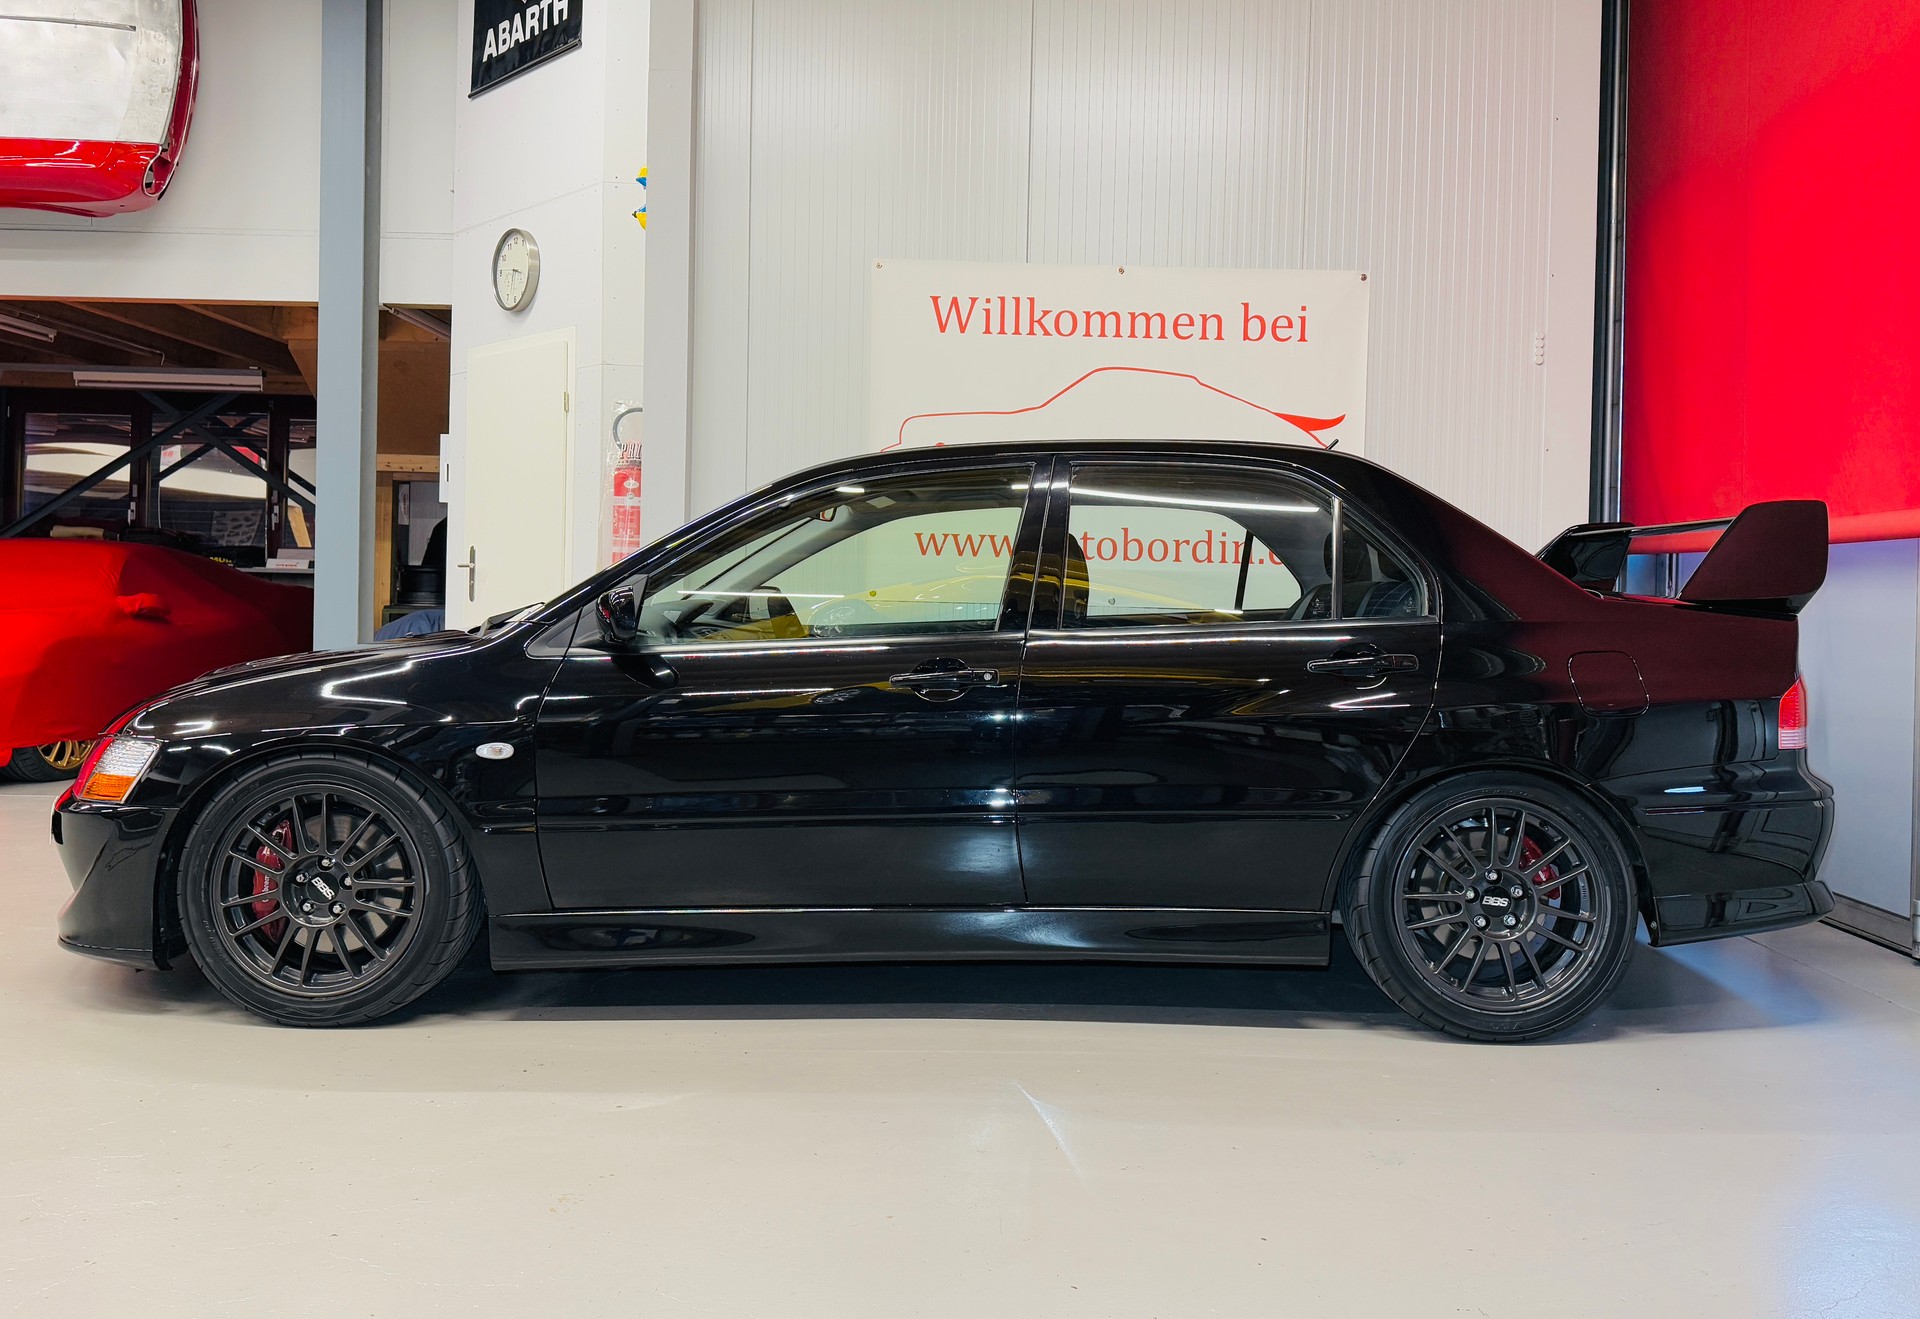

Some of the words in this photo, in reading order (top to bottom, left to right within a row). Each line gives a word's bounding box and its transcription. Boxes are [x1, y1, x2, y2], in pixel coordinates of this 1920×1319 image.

[482, 0, 569, 63] ABARTH
[513, 237, 519, 245] 12
[501, 254, 507, 262] 10
[930, 295, 1225, 342] Willkommen
[1241, 302, 1309, 344] bei
[311, 876, 335, 899] BBS
[1482, 896, 1509, 907] BBS
